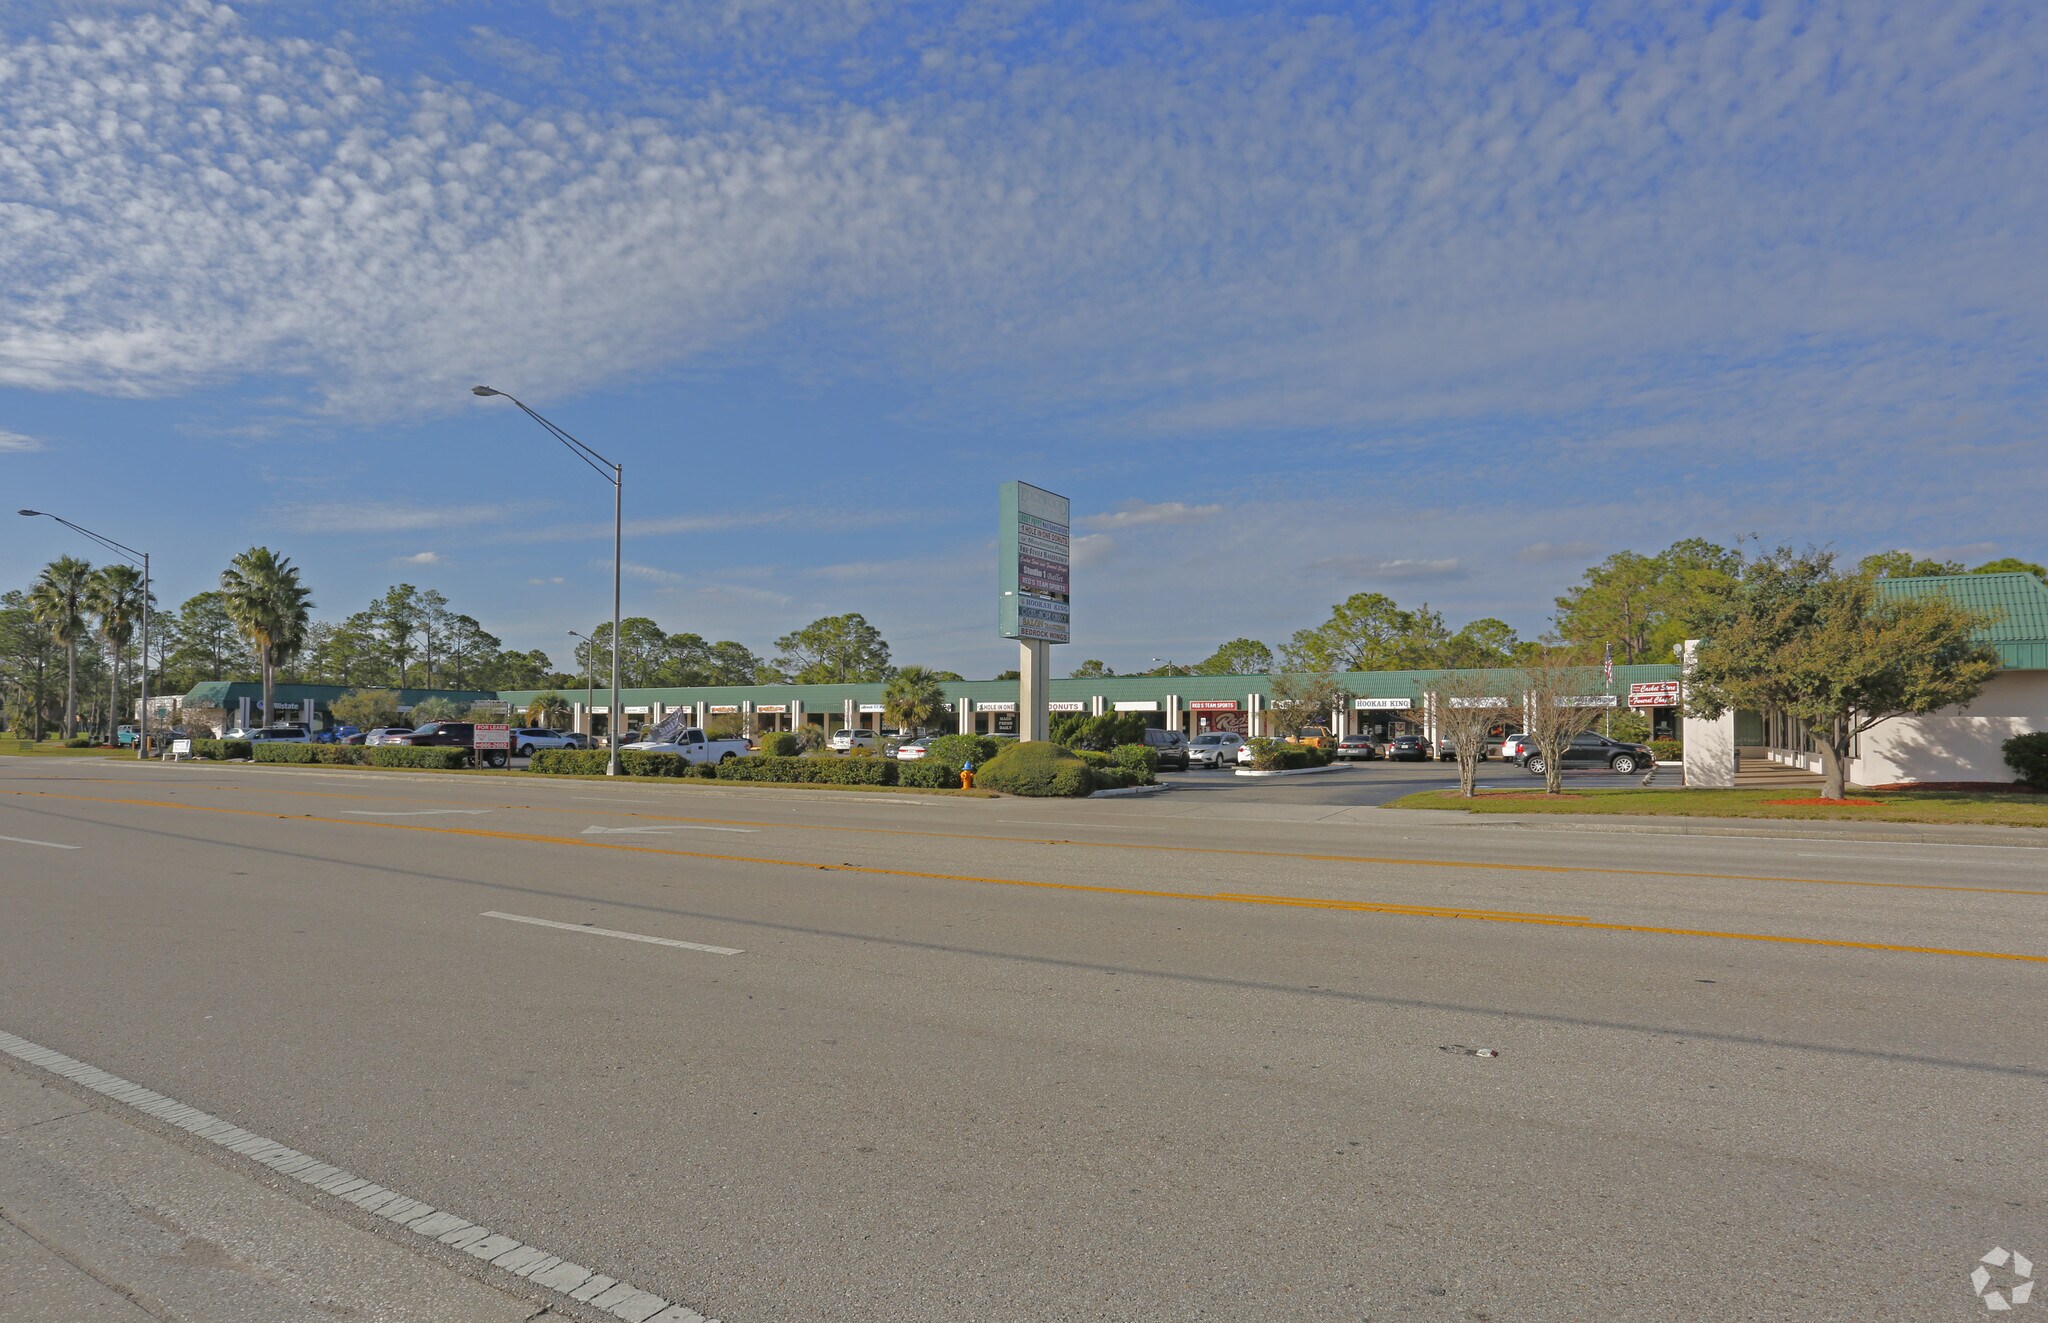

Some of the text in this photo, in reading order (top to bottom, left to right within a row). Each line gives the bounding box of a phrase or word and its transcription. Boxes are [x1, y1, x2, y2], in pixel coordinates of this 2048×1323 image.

[1025, 525, 1036, 536] HOLE
[1042, 531, 1051, 540] ONE
[1051, 533, 1068, 544] DONUTS
[1023, 566, 1043, 577] Studio
[1036, 580, 1049, 589] TEAM
[1049, 582, 1066, 592] SPORTS
[1026, 598, 1068, 612] HOOKAH KING
[1021, 627, 1068, 641] BEDROCK WINGS
[1640, 684, 1659, 692] Casket
[1632, 696, 1653, 704] Funeral
